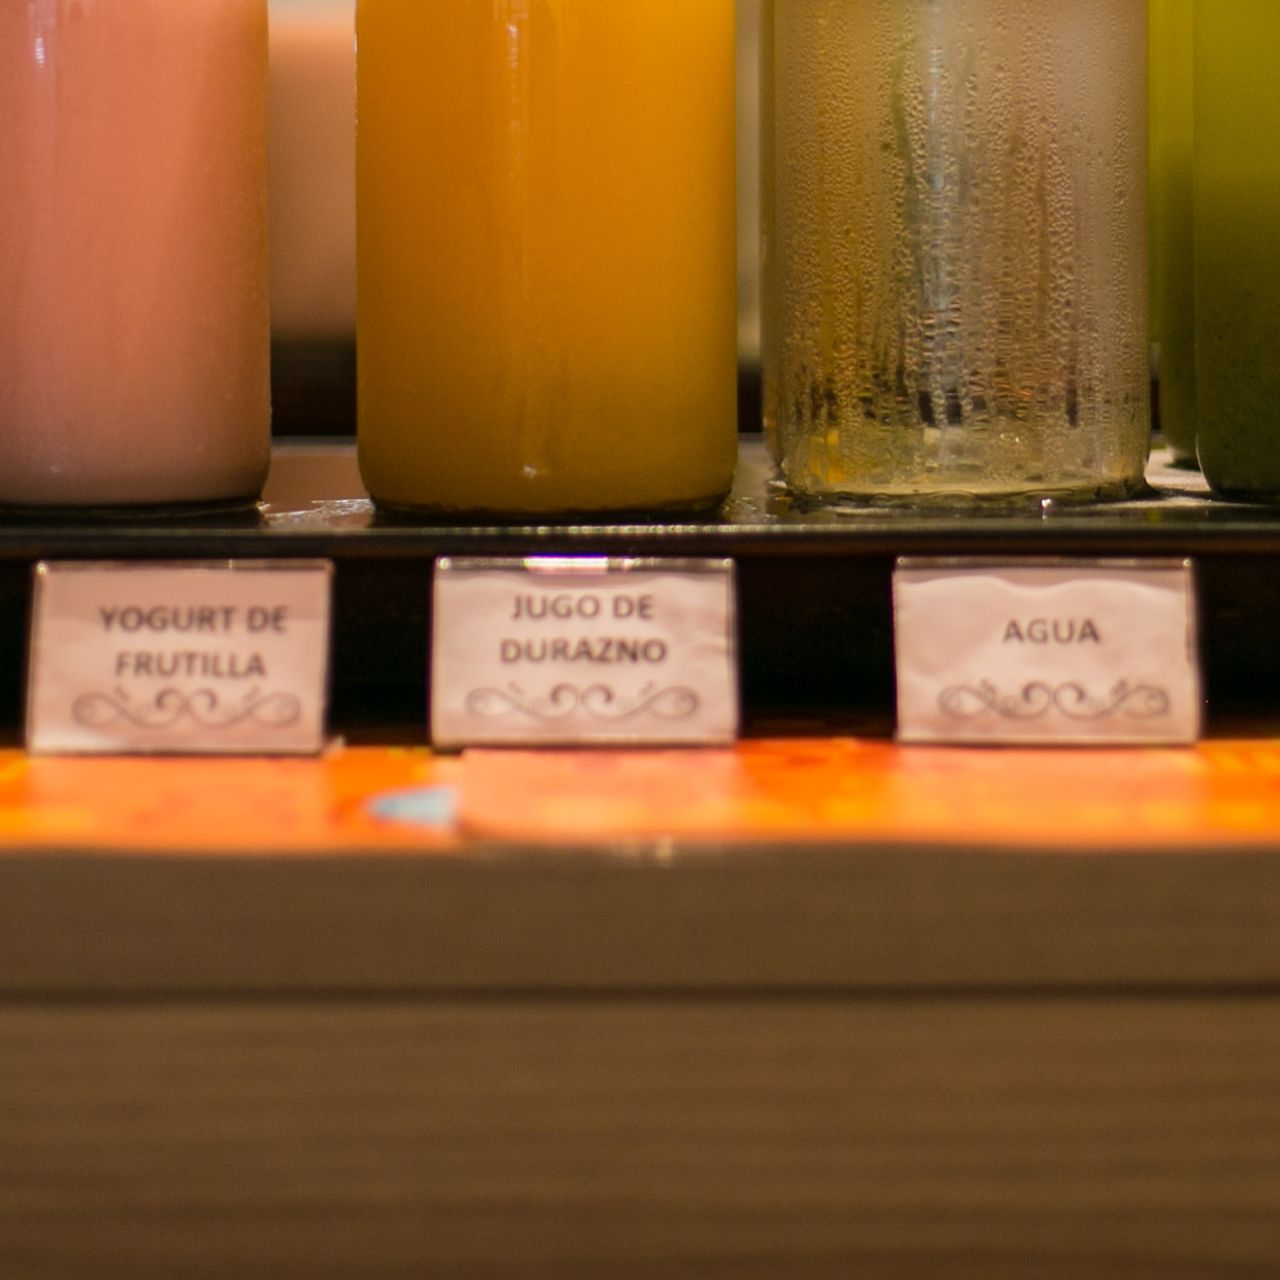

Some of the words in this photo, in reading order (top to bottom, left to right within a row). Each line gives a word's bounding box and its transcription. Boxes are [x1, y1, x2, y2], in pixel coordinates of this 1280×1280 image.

[99, 607, 236, 633] YOGURT
[248, 607, 288, 632] DE
[511, 594, 602, 621] JUGO
[613, 595, 656, 618] DE
[1003, 618, 1101, 644] AGUA
[116, 653, 267, 677] FRUTILLA
[501, 639, 669, 665] DURAZNO
